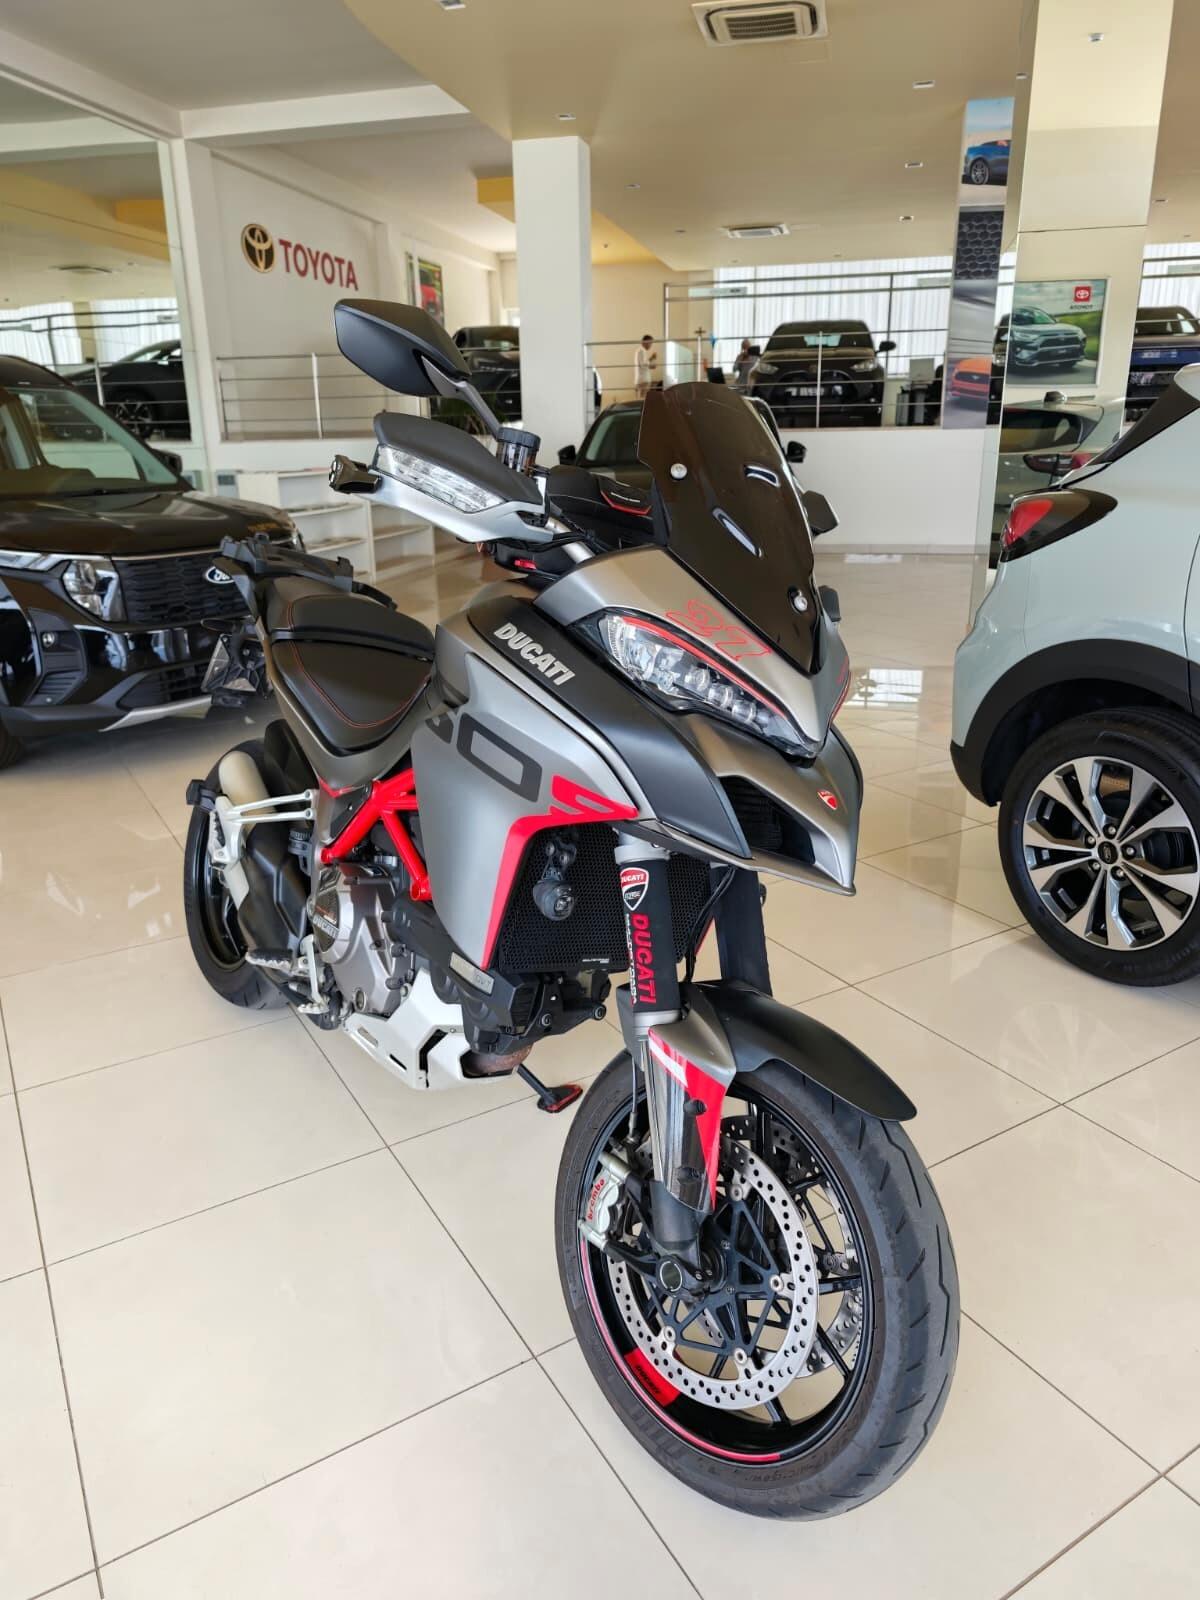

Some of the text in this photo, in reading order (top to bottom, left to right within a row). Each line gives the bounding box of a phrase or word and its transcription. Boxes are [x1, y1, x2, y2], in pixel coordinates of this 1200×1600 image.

[278, 239, 359, 292] TOYOTA
[494, 622, 576, 686] DUCATI
[620, 874, 645, 883] UCATI
[631, 913, 656, 1004] DUCATI
[587, 1179, 605, 1220] brembo
